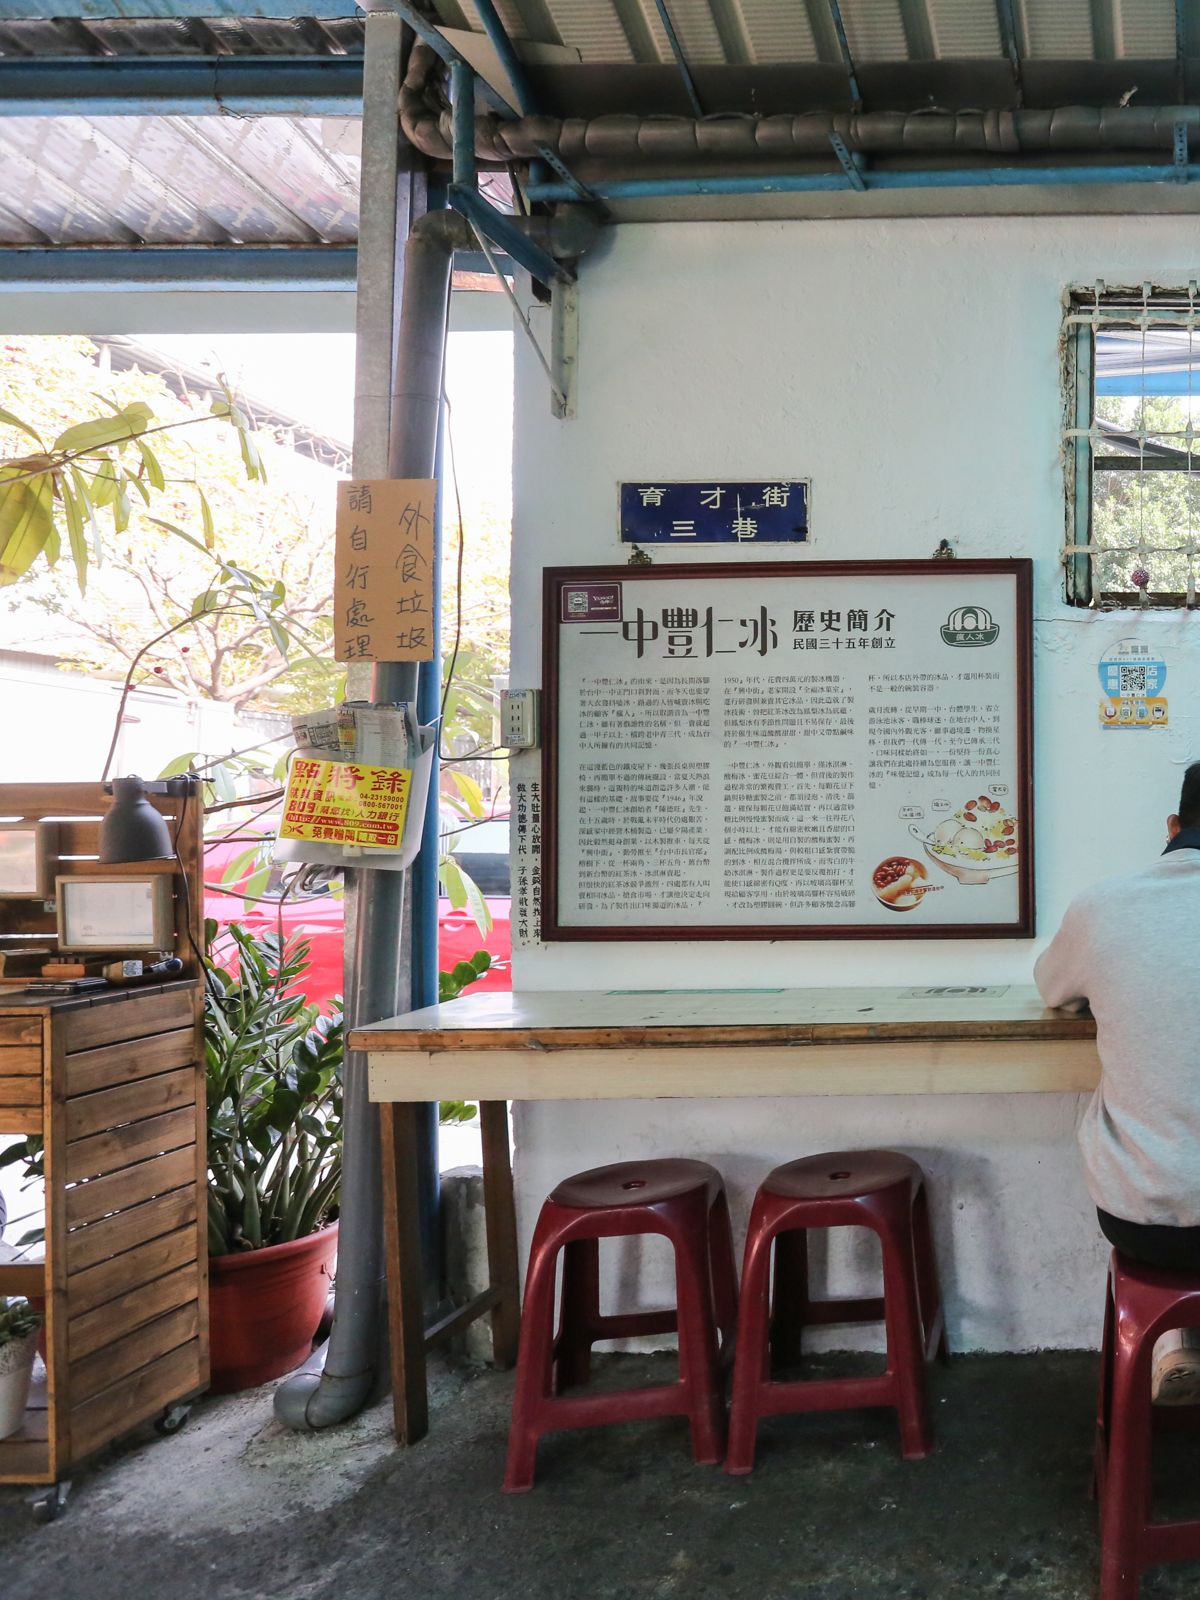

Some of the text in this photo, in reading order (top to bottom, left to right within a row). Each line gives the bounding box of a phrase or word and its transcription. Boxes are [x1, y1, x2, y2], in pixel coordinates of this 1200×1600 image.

[638, 485, 790, 508] 育才街
[670, 518, 758, 540] 三巷
[344, 484, 378, 660] 請自行處理
[396, 501, 430, 649] 外食垃圾
[579, 605, 896, 659] 一中豐仁冰 歷史簡介
[792, 637, 897, 650] 民國三十五年創立
[292, 761, 407, 794] 點將錄
[359, 801, 403, 810] 0800-567001
[360, 793, 404, 802] 04-23159000
